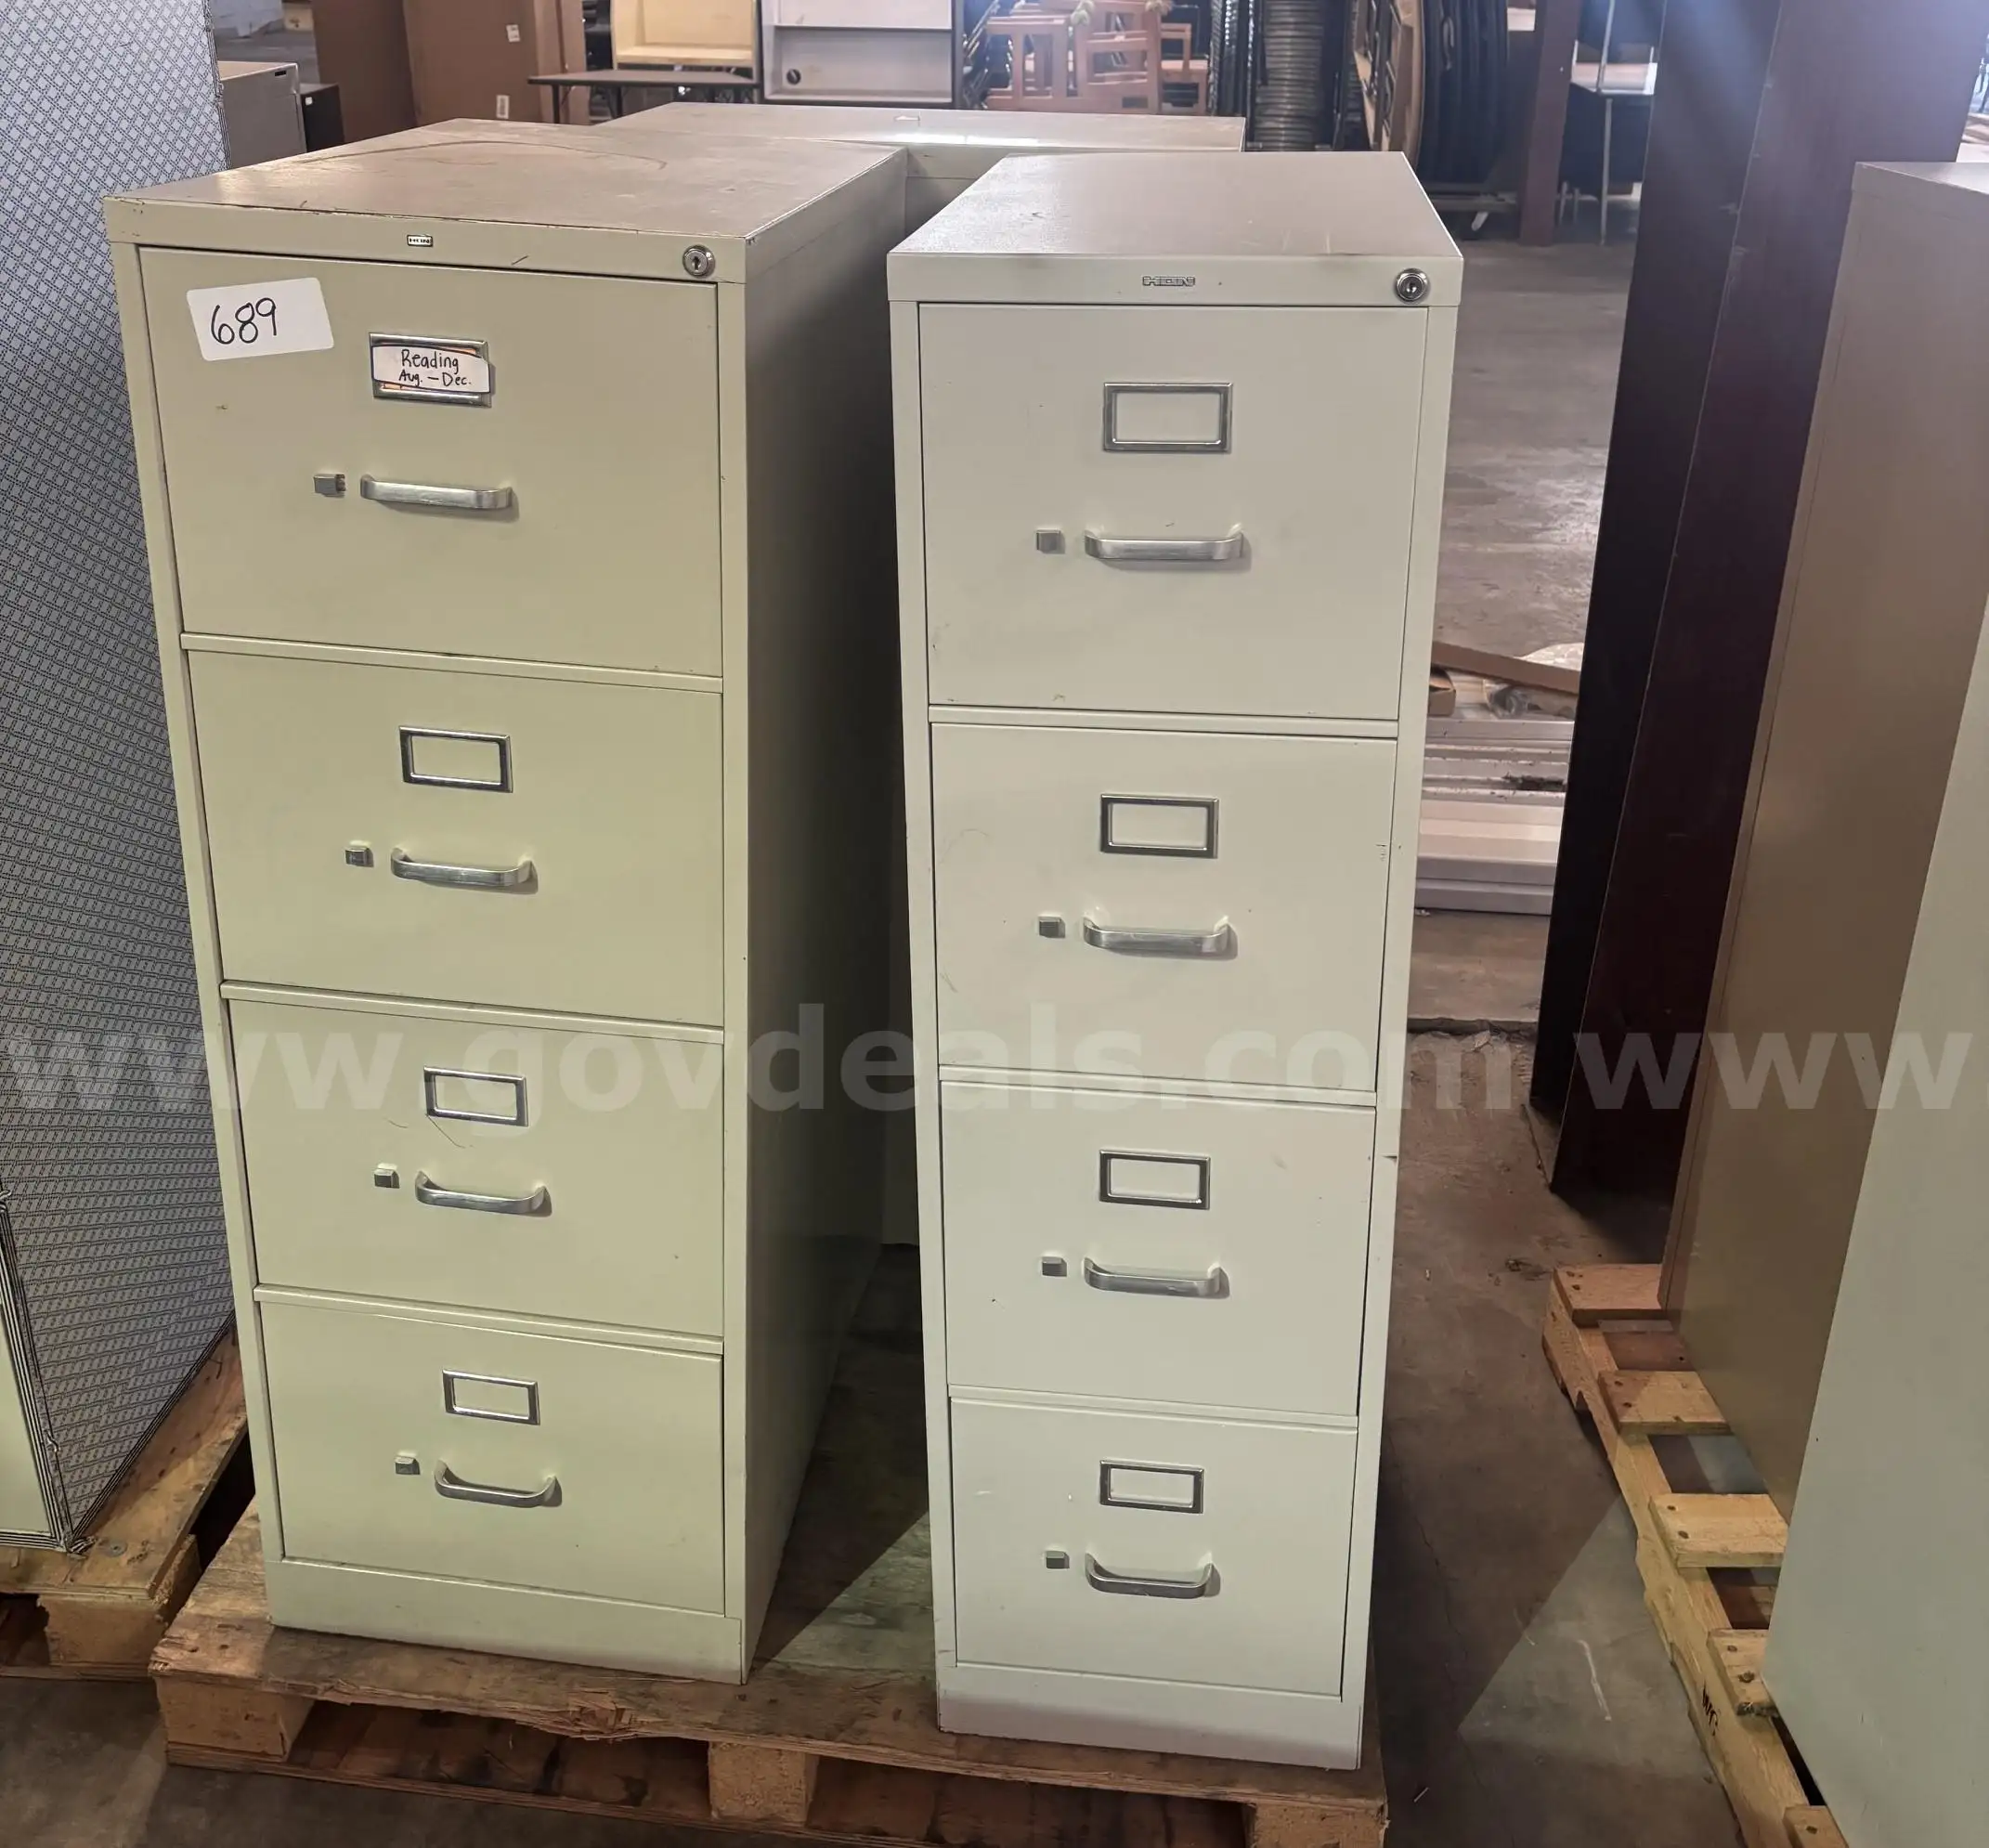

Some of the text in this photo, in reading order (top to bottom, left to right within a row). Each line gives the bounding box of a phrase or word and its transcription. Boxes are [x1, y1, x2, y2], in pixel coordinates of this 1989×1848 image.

[1142, 276, 1195, 287] HON
[210, 296, 278, 345] 689
[400, 348, 460, 375] Reading
[398, 369, 423, 387] Aug.
[441, 371, 472, 387] Dec.
